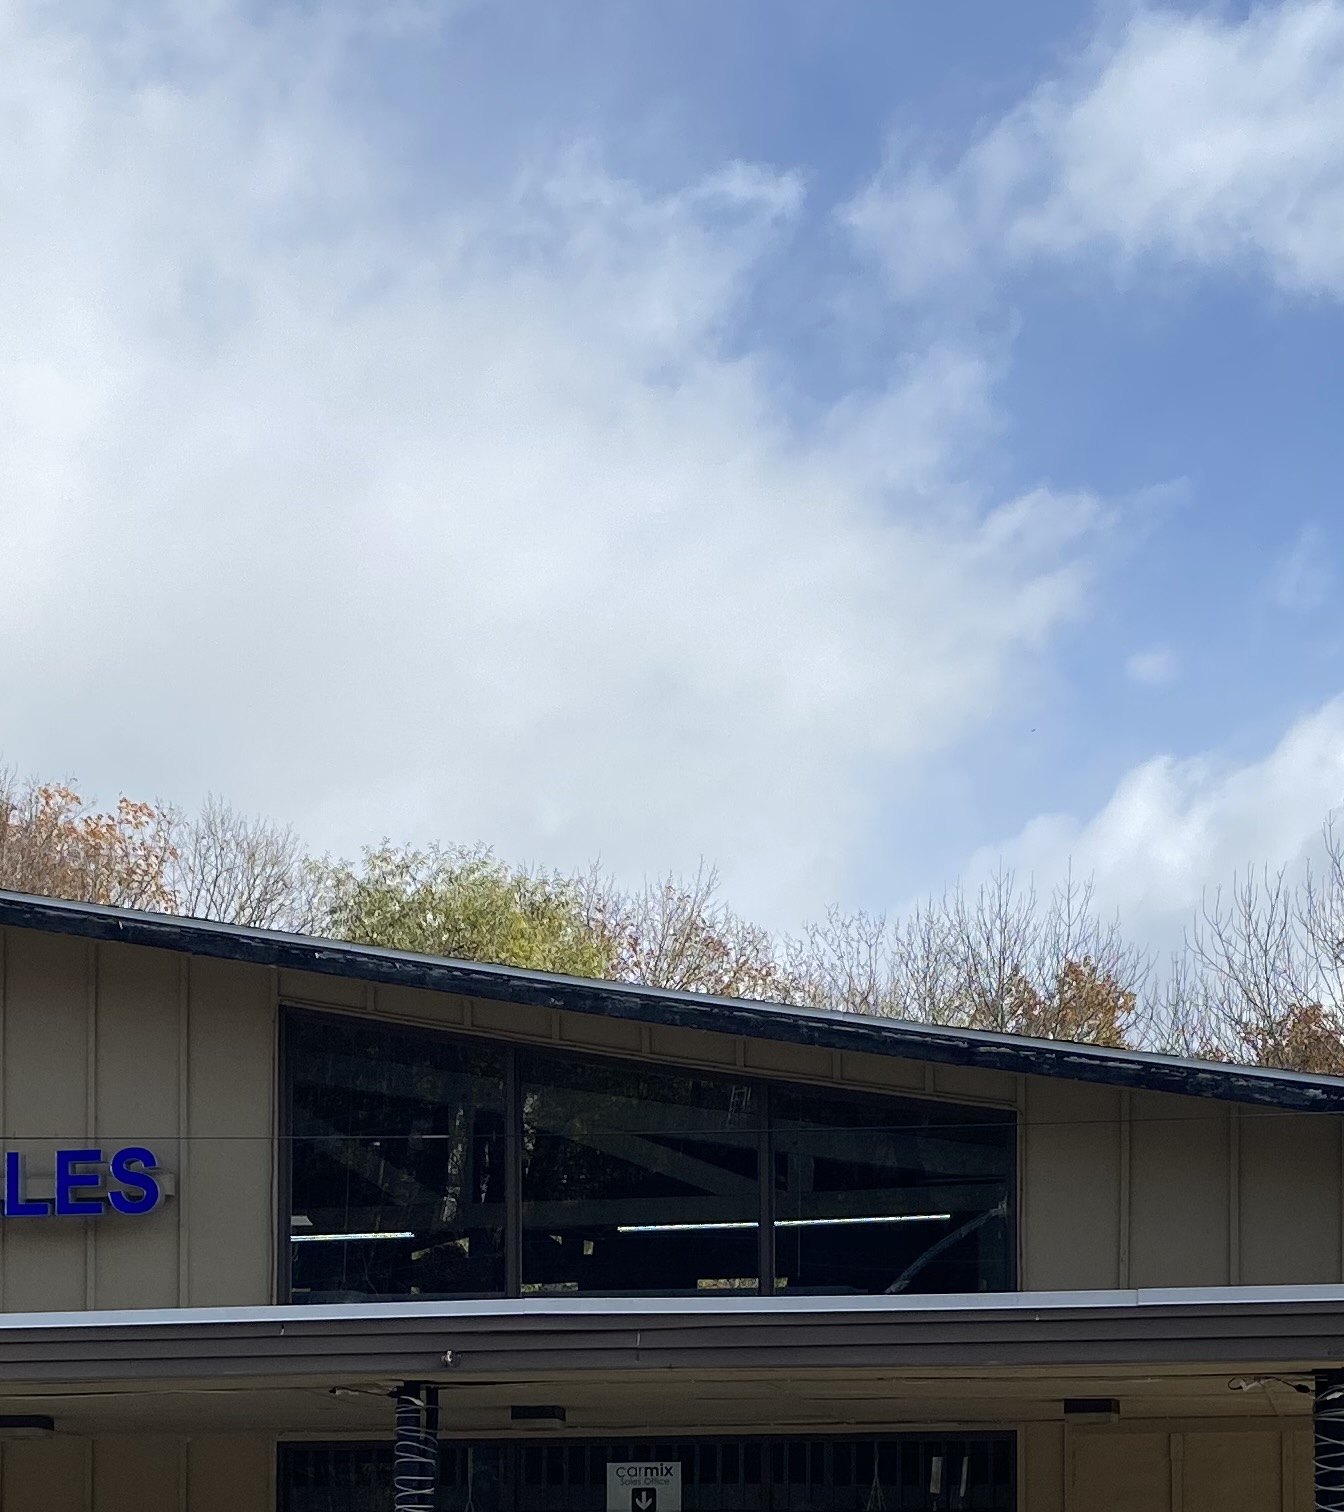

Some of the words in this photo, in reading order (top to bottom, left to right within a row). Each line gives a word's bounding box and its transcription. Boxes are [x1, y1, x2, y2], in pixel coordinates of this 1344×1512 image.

[616, 1463, 674, 1478] carmix
[620, 1477, 642, 1486] Sales
[643, 1477, 670, 1486] Office
